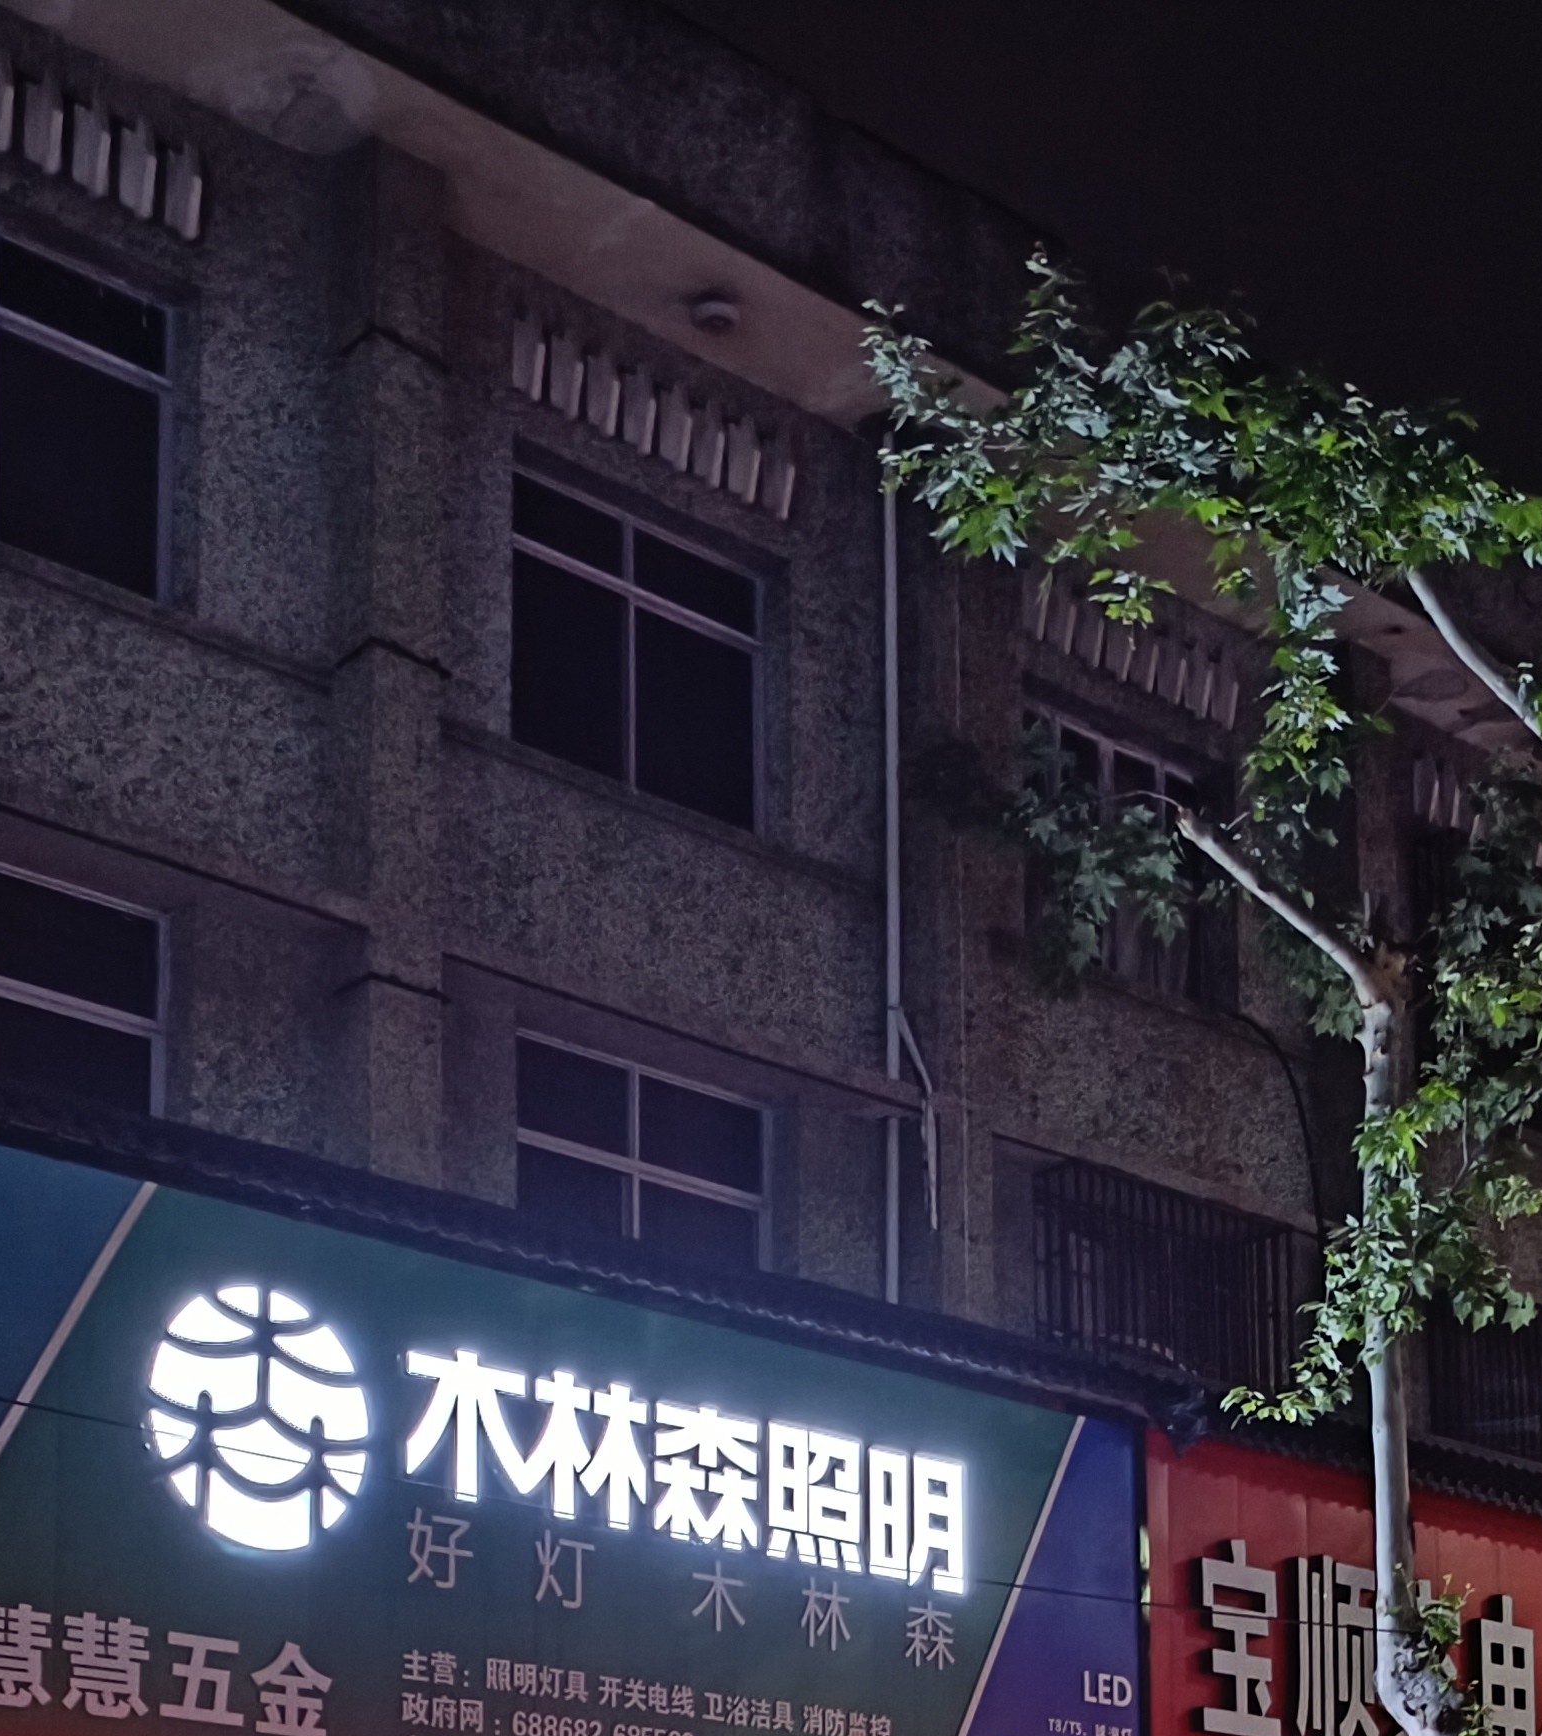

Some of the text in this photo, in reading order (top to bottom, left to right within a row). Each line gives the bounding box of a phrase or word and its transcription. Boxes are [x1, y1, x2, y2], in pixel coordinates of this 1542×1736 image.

[405, 1348, 965, 1596] 木林森照明
[407, 1506, 956, 1671] 好灯木林森
[598, 1674, 695, 1720] 开关电线
[702, 1690, 796, 1735] 卫浴洁具
[1083, 1670, 1133, 1708] LED
